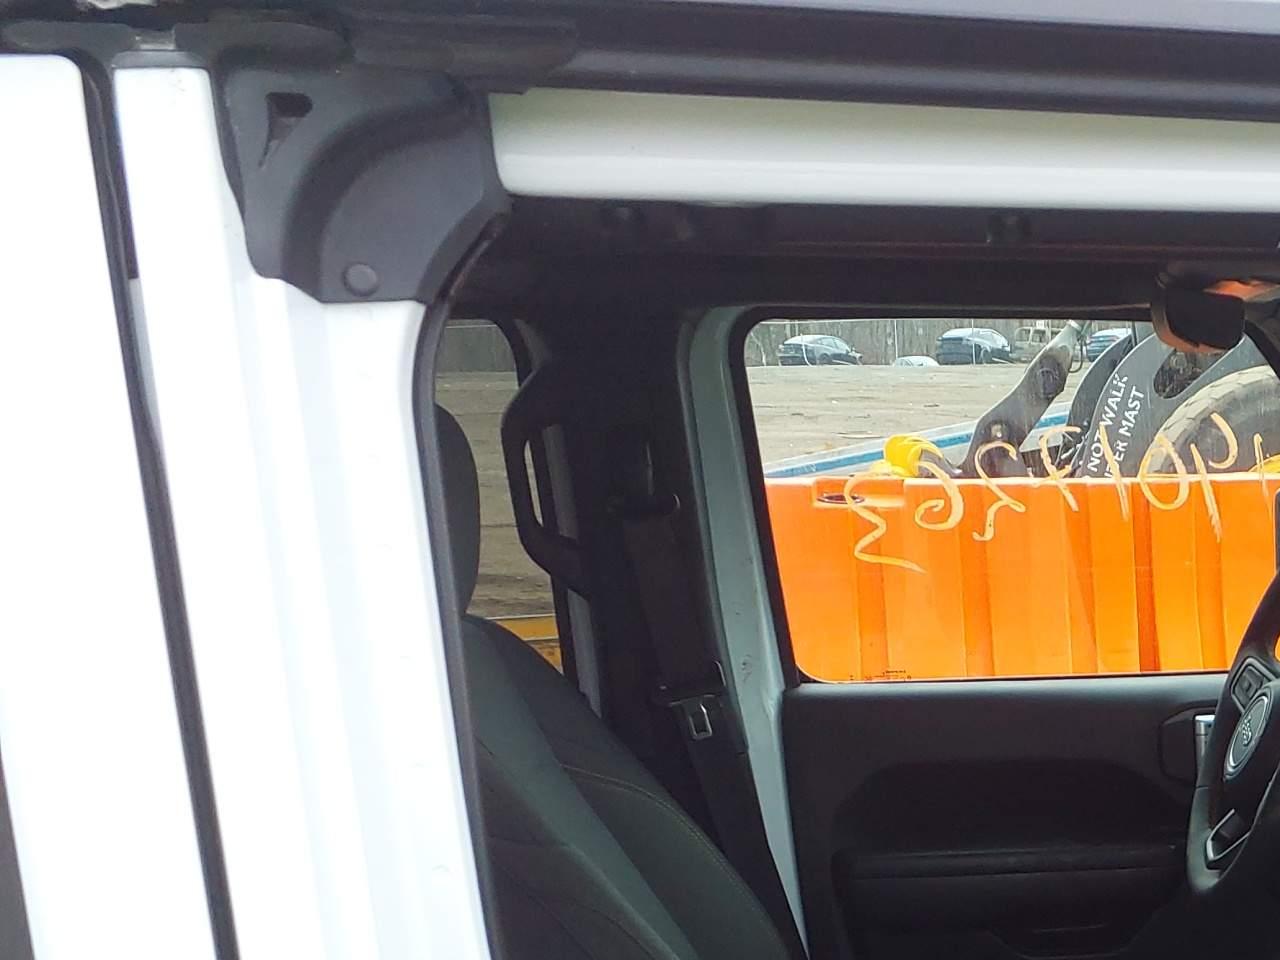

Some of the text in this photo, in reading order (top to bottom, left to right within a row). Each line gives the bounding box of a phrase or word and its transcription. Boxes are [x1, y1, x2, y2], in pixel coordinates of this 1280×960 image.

[1087, 429, 1104, 472] NOT
[1099, 373, 1128, 426] WALK
[1119, 386, 1144, 437] MAST
